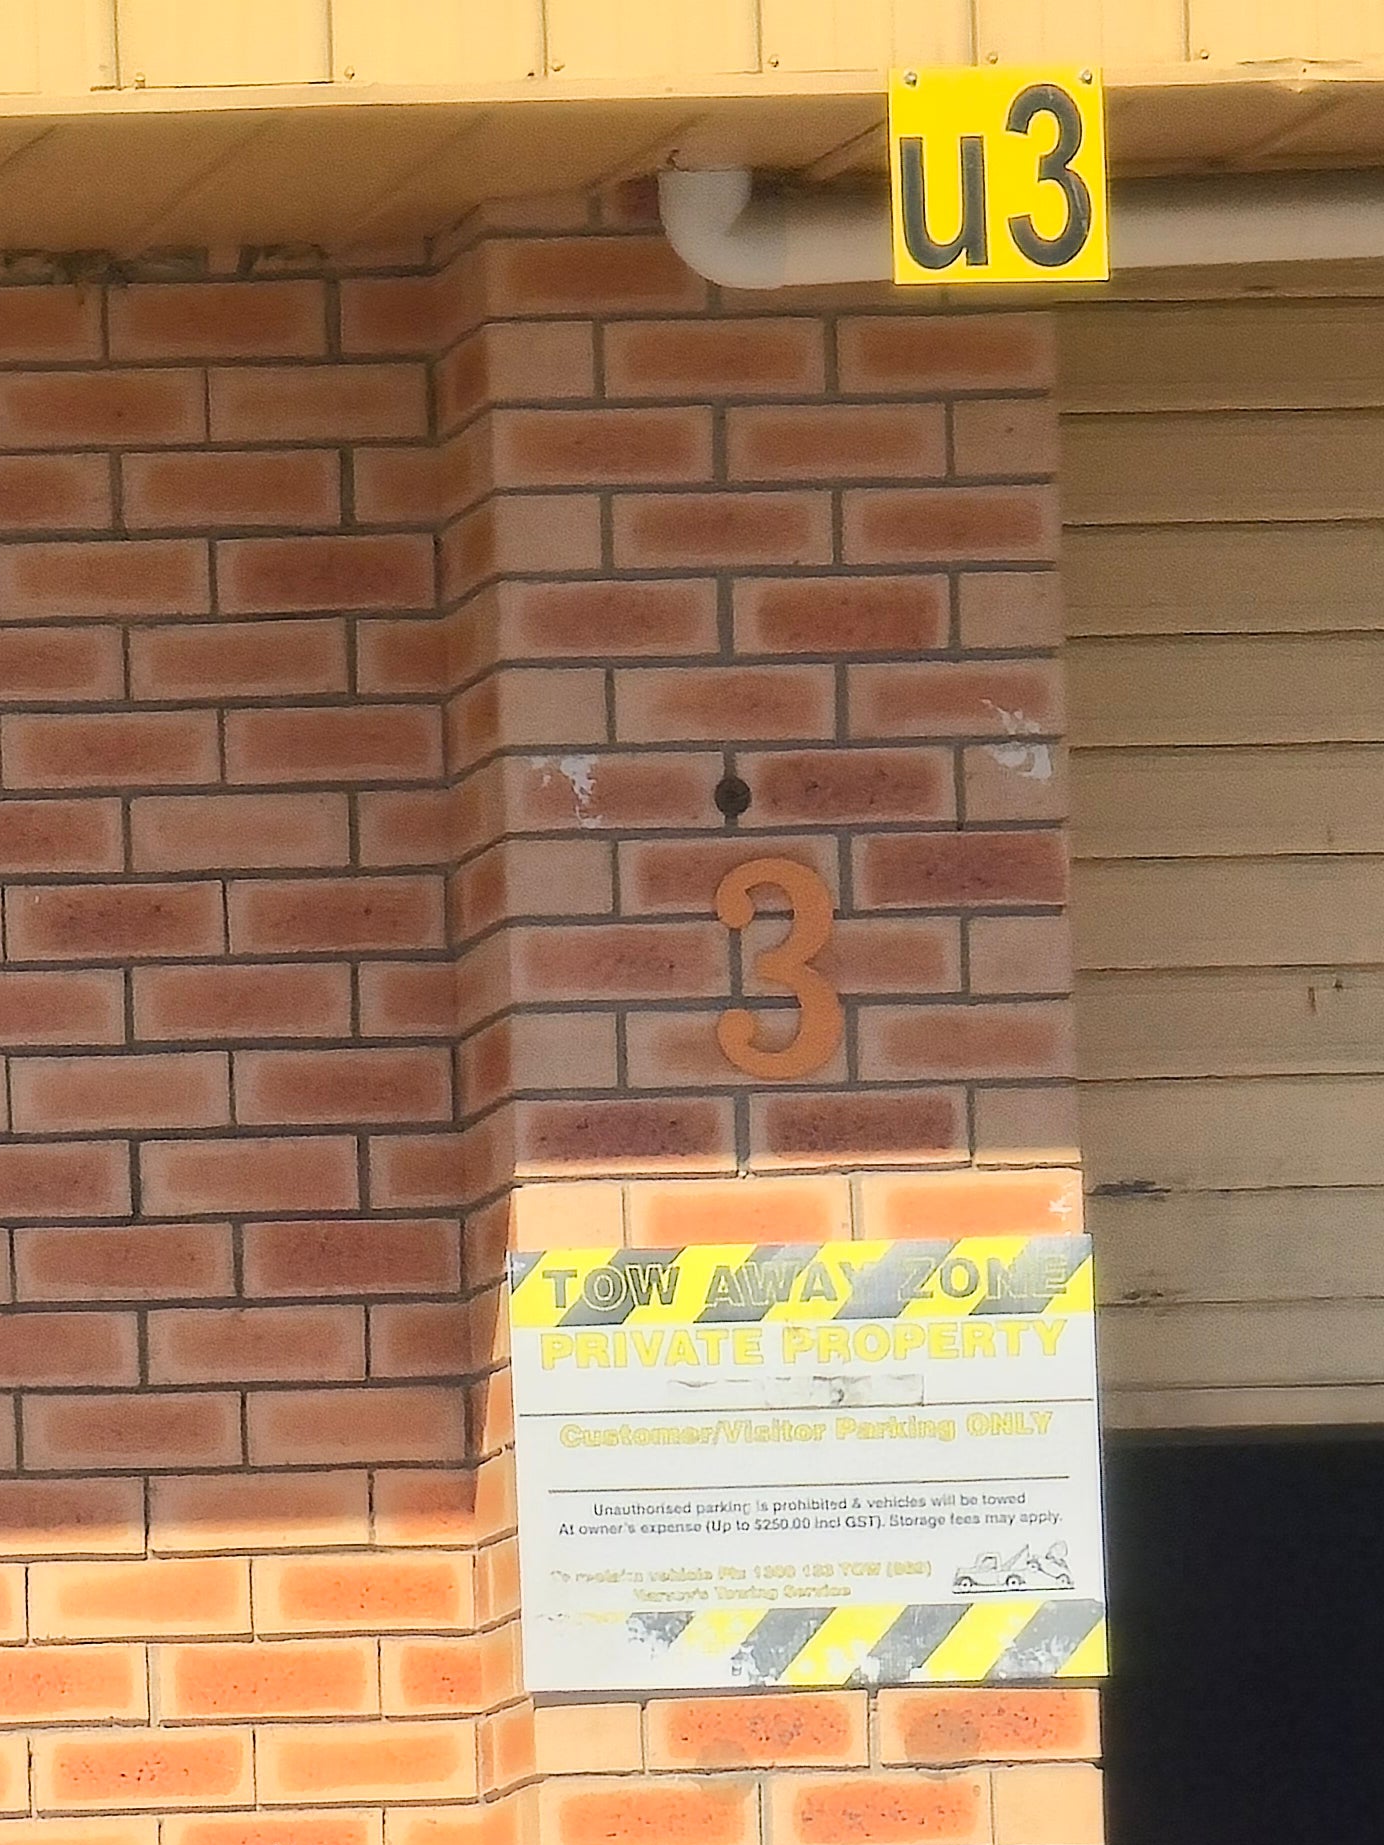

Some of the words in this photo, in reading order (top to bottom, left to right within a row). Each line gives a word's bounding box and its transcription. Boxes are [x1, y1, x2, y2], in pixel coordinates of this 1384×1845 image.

[899, 83, 1092, 270] u3
[715, 857, 843, 1081] 3
[542, 1264, 680, 1311] TOW
[705, 1257, 878, 1308] AWAY
[897, 1254, 1067, 1300] ZONE
[540, 1327, 764, 1371] PRIVATE
[783, 1319, 1067, 1366] PROPERTY
[559, 1417, 826, 1448] Customer/Visitor
[836, 1416, 956, 1442] Parking
[966, 1410, 1054, 1437] ONLY
[559, 1523, 575, 1536] At
[579, 1522, 636, 1536] owner's
[640, 1521, 702, 1536] expense
[706, 1519, 732, 1534] (Up
[736, 1519, 750, 1531] to
[815, 1515, 840, 1529] incl
[889, 1513, 945, 1529] Storage
[950, 1512, 980, 1526] fees
[985, 1513, 1014, 1526] may
[1020, 1510, 1063, 1525] apply.
[593, 1502, 692, 1517] Unauthorised
[696, 1501, 750, 1517] parking
[756, 1500, 768, 1512] is
[773, 1497, 847, 1515] prohibited
[851, 1497, 861, 1510] &
[868, 1494, 926, 1509] vehicles
[930, 1494, 955, 1507] will
[960, 1493, 977, 1506] be
[981, 1492, 1026, 1505] towed
